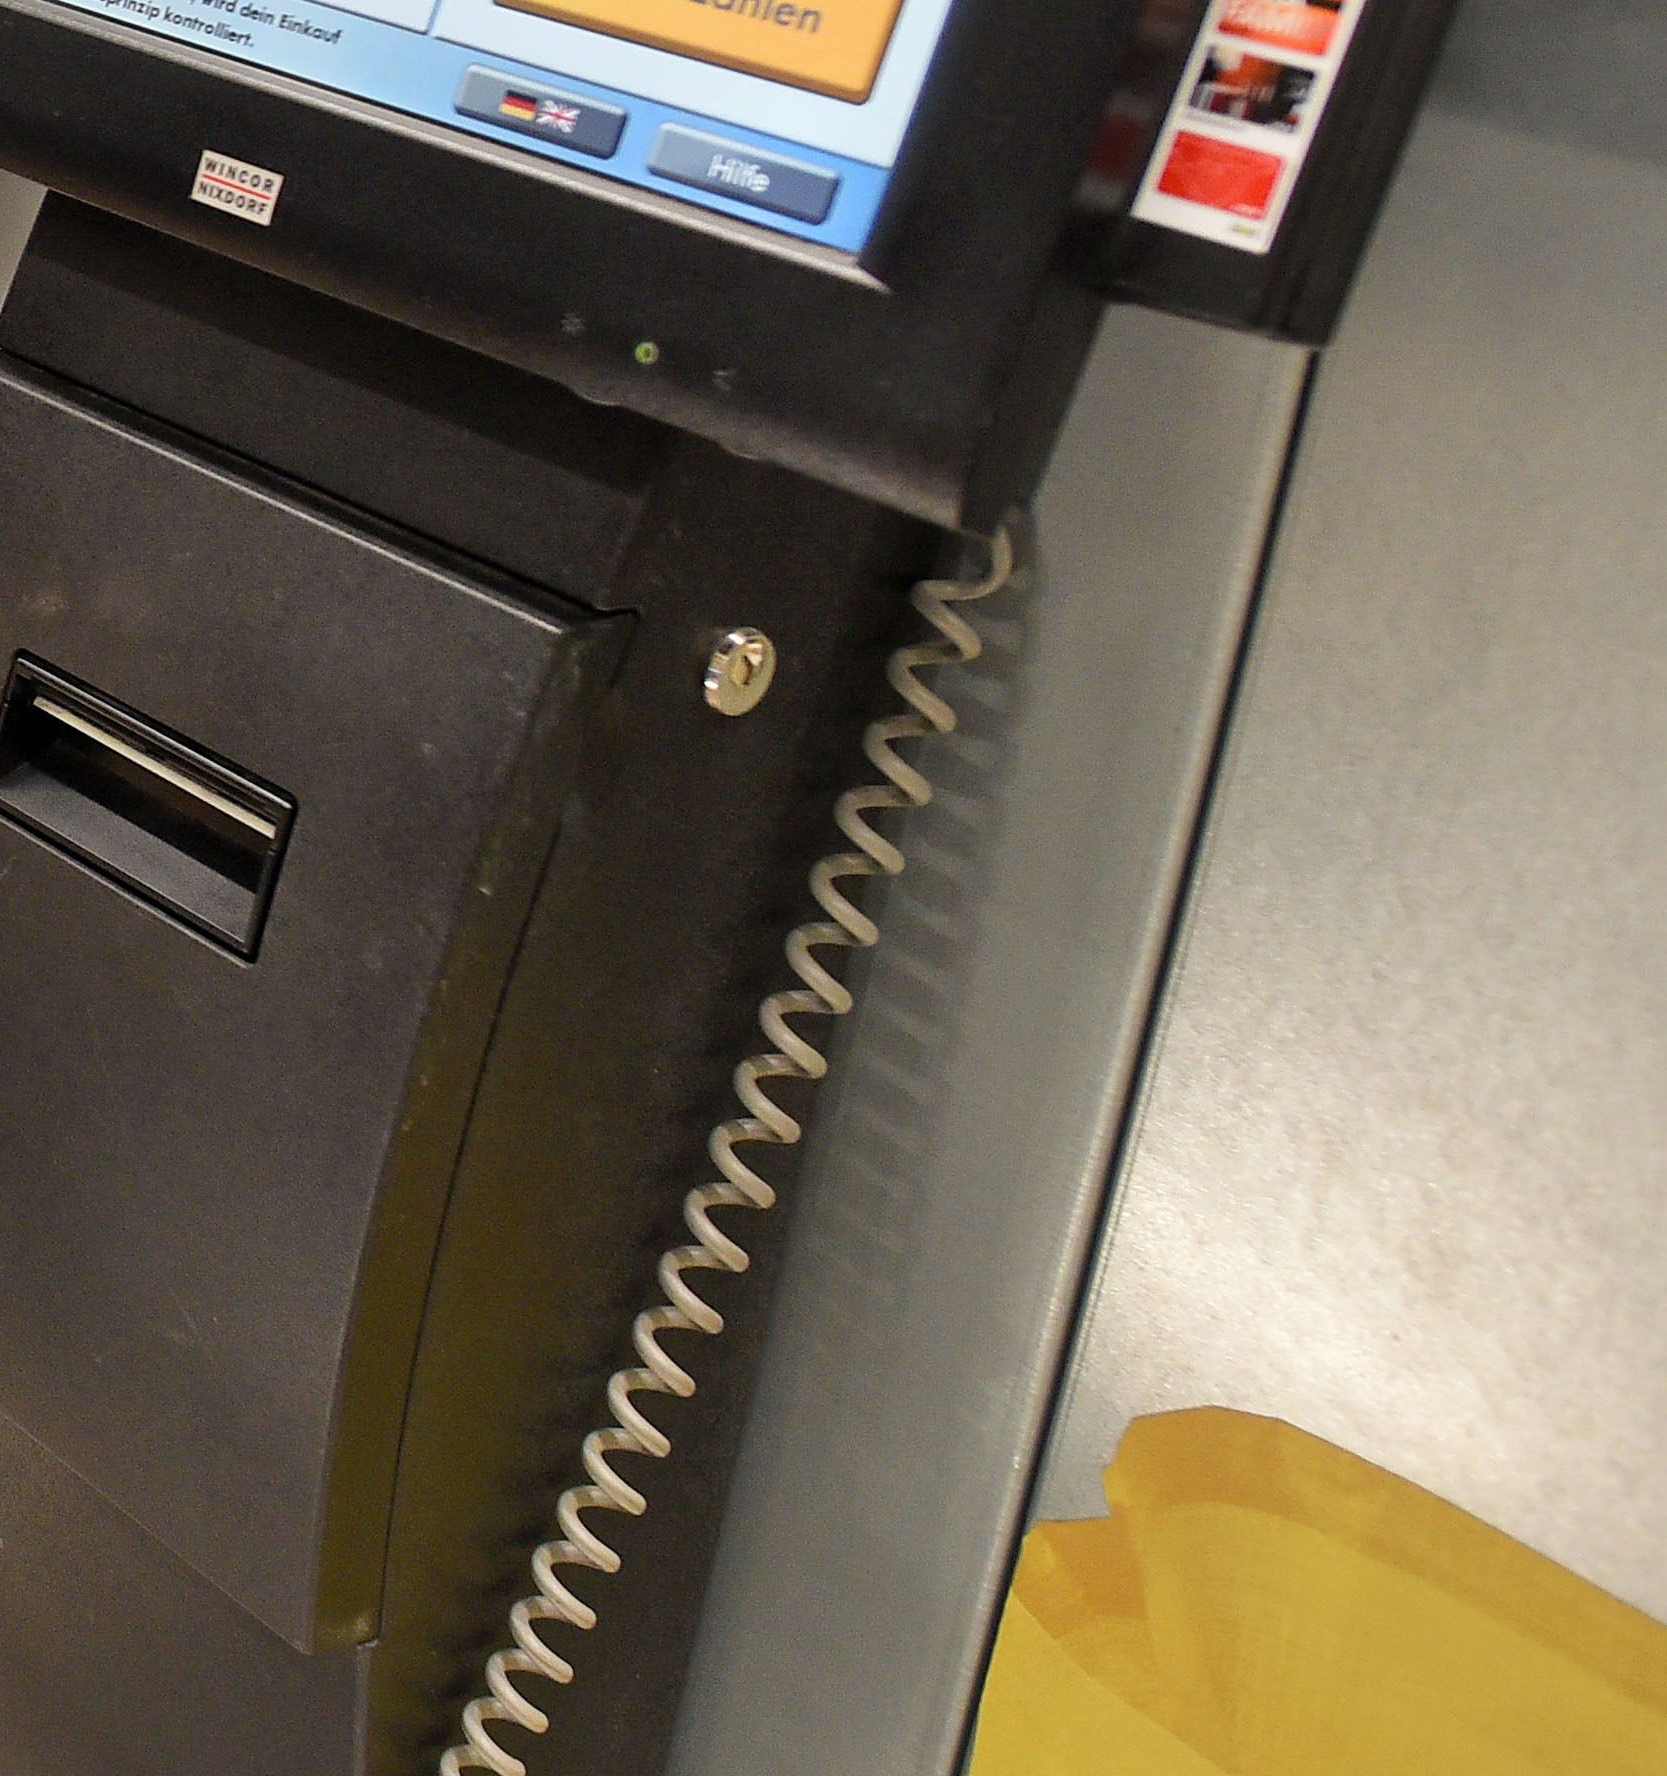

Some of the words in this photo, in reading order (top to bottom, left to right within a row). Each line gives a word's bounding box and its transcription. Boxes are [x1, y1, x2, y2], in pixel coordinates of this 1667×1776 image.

[162, 6, 258, 48] kontrolliert.
[238, 0, 277, 26] dein
[276, 11, 344, 46] Einkauf
[205, 158, 273, 192] WINCOR
[705, 151, 774, 197] Hilfe
[198, 182, 268, 214] NIXDORF
